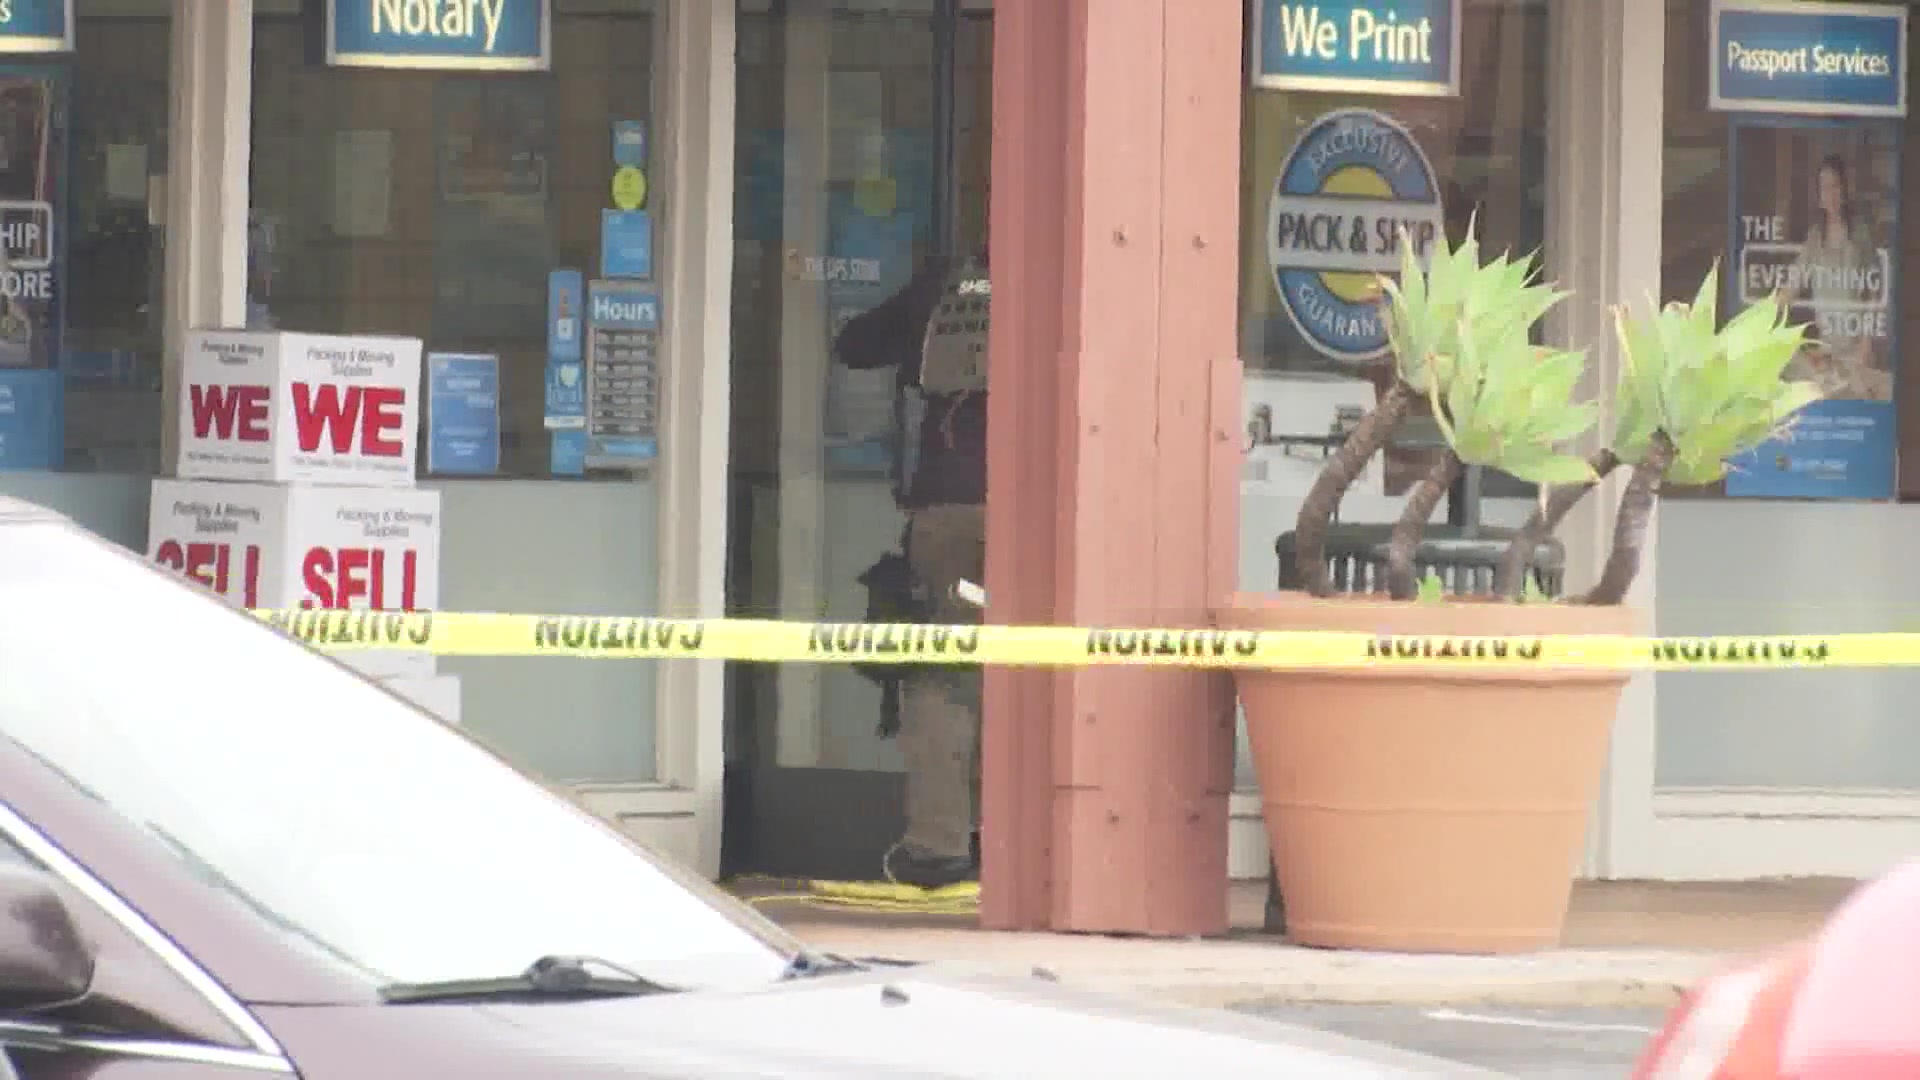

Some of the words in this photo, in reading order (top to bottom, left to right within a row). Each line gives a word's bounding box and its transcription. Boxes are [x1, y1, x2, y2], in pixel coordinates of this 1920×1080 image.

[371, 0, 504, 50] Notary
[1281, 4, 1338, 60] We
[1350, 9, 1432, 63] Print
[1727, 40, 1807, 80] Passport
[1812, 44, 1890, 76] Services
[1279, 212, 1342, 252] PACK
[1350, 215, 1367, 253] &
[1742, 216, 1784, 241] THE
[959, 279, 992, 295] SHE
[1749, 264, 1881, 290] EVERYTHING
[593, 295, 656, 321] Hours
[1299, 283, 1377, 336] GUARAN
[1821, 311, 1887, 337] STORE
[190, 384, 271, 441] WE
[291, 381, 406, 457] WE
